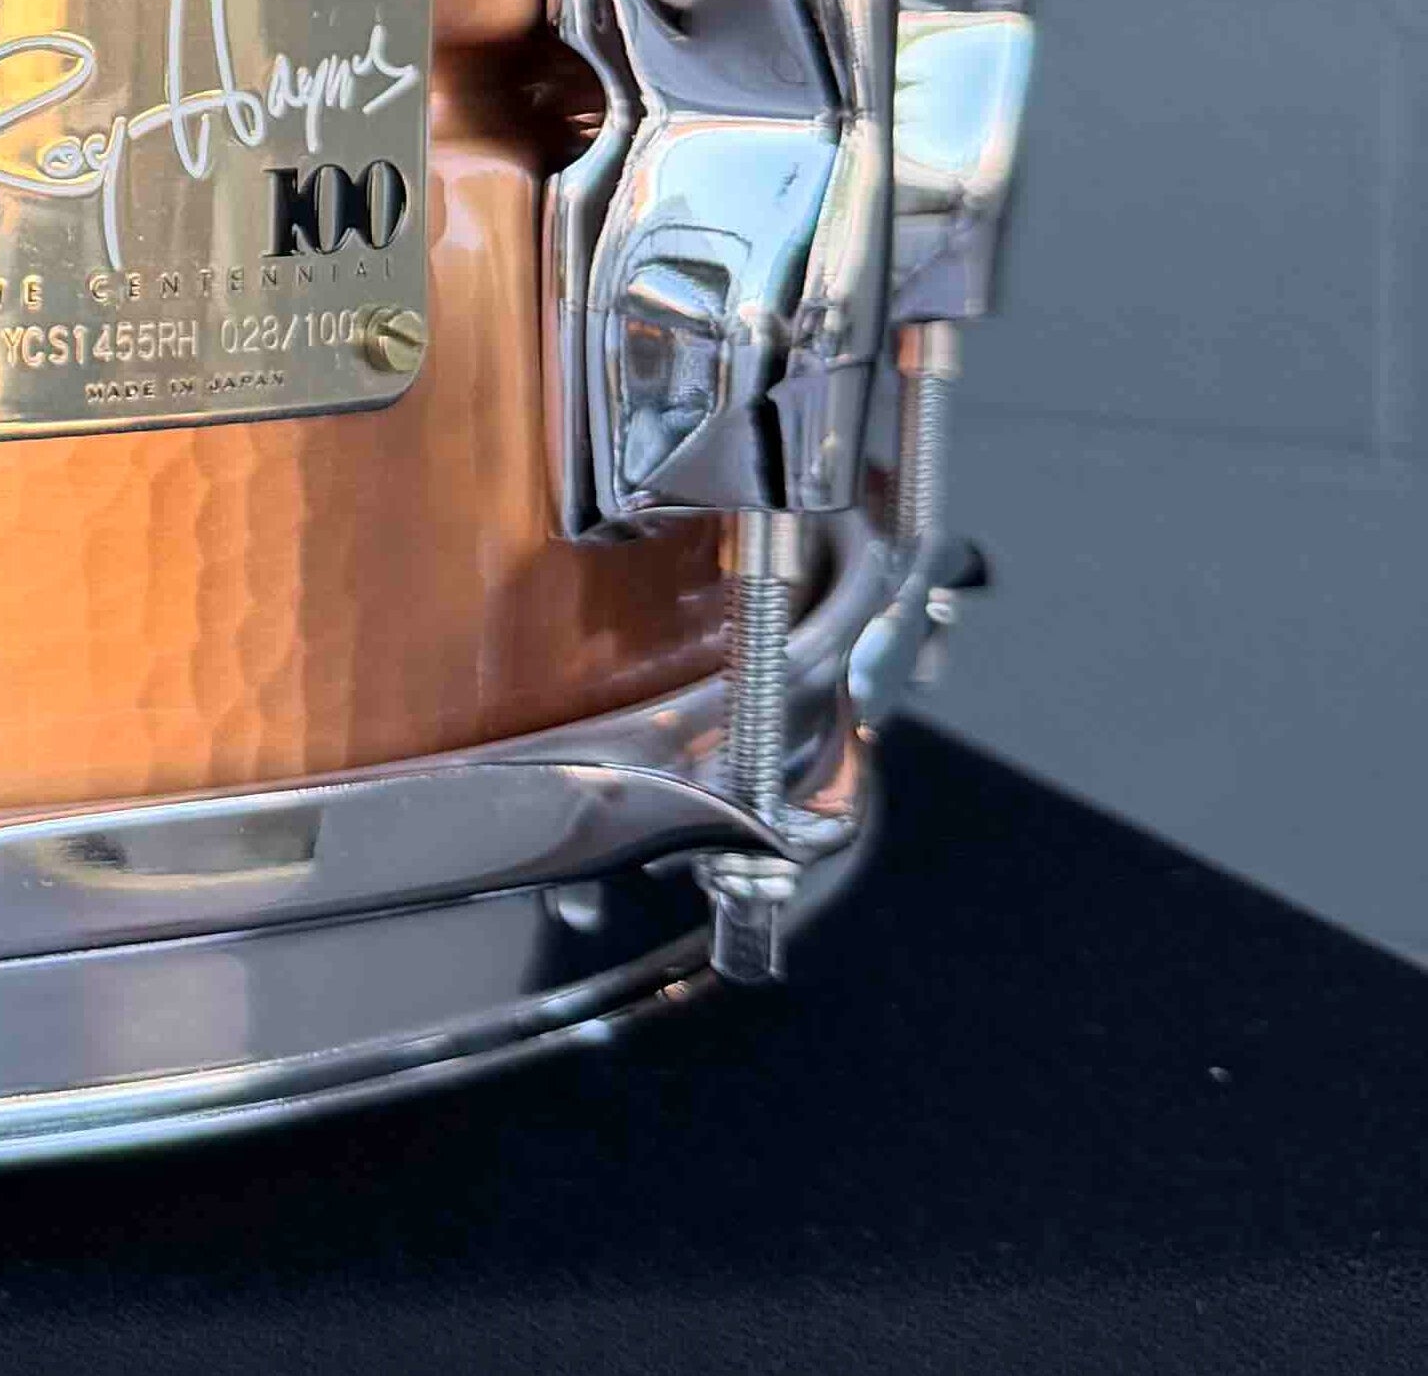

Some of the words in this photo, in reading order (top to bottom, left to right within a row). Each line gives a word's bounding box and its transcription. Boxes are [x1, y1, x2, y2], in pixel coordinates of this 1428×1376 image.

[261, 160, 412, 259] 100
[89, 260, 395, 304] CENTENNIAL
[0, 320, 198, 369] YCS1455RH
[85, 381, 156, 403] MADE
[170, 379, 196, 397] IN
[208, 370, 287, 393] JAPAN
